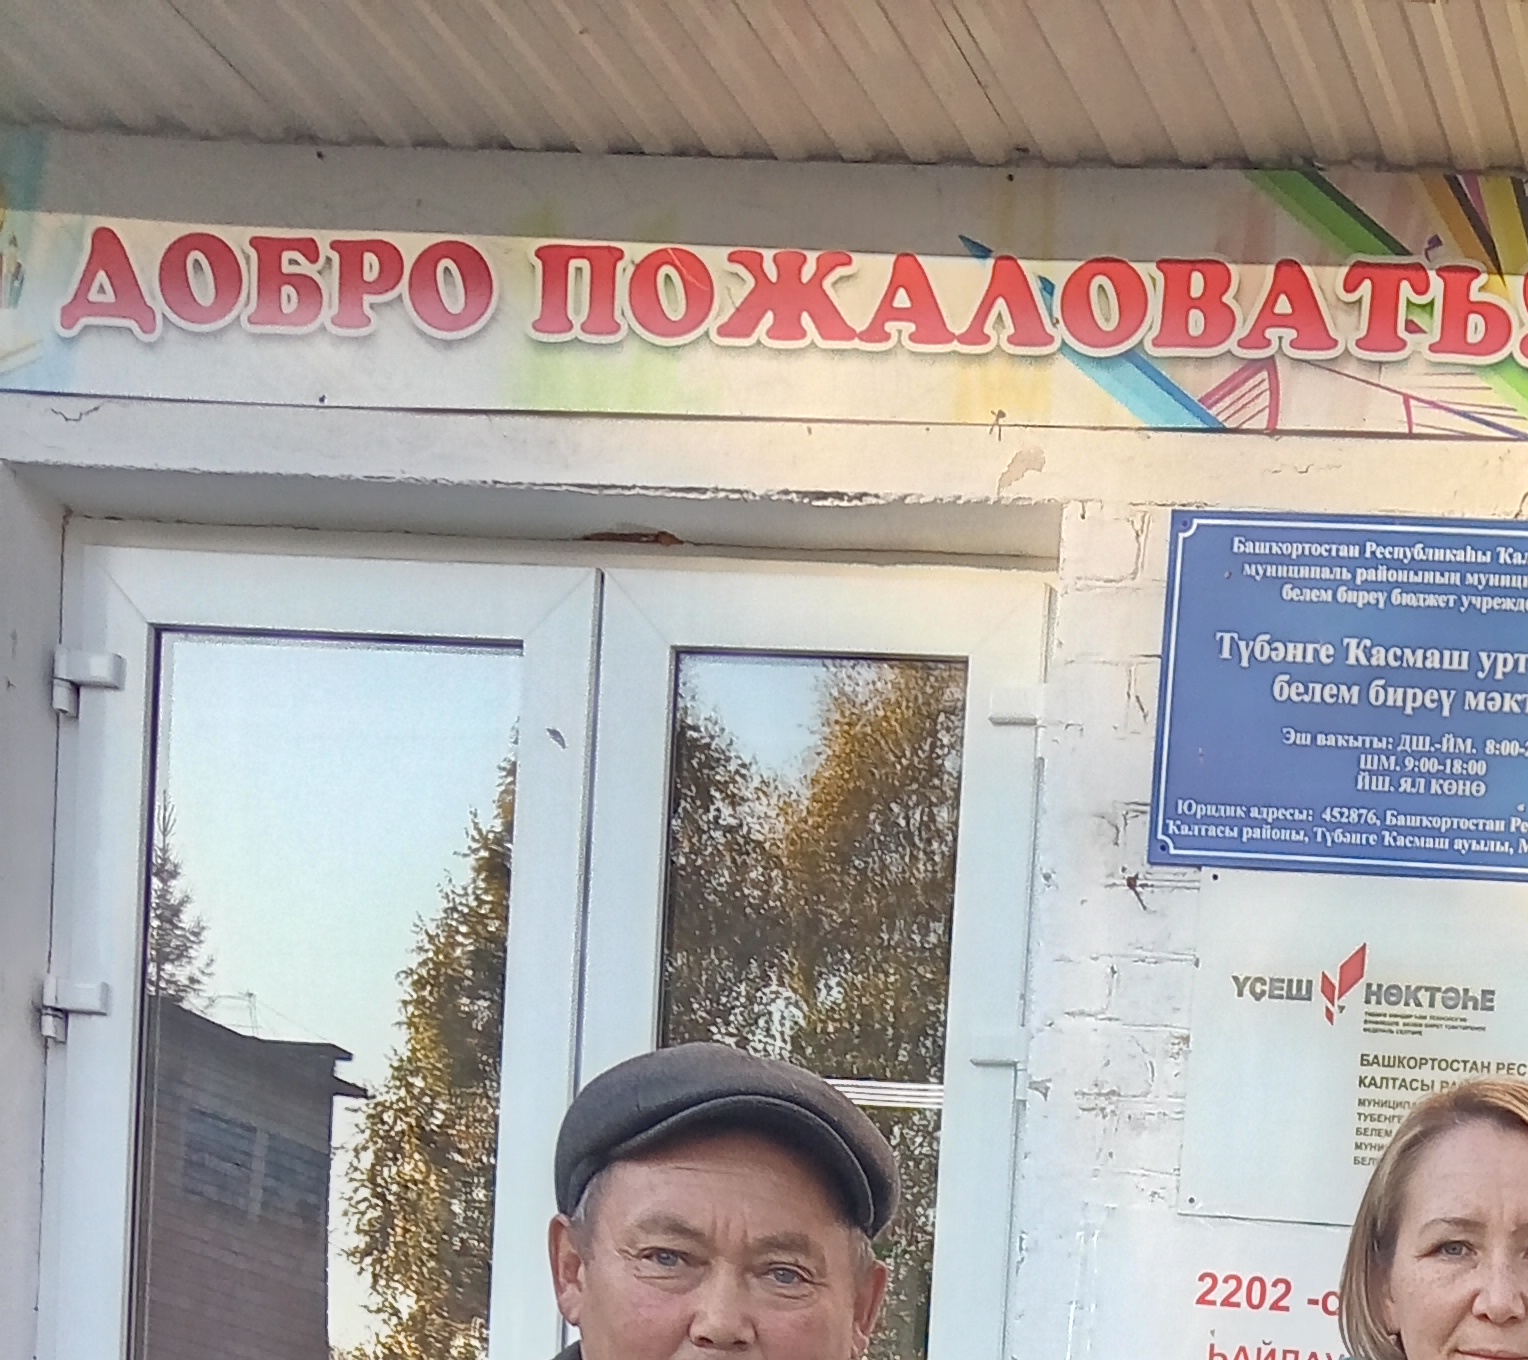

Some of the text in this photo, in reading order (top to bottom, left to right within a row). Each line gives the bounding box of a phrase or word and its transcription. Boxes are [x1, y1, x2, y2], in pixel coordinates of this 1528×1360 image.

[57, 225, 496, 338] ДОБРО
[1364, 541, 1492, 565] Республикаһы
[1242, 562, 1352, 582] муниципаль
[1281, 583, 1332, 603] белем
[1390, 588, 1458, 609] бюджет
[1215, 631, 1336, 669] Түбәнге
[1342, 637, 1470, 672] Ҡасмаш
[1272, 673, 1361, 705] белем
[1368, 679, 1457, 717] биреү
[1282, 727, 1311, 746] Эш
[1397, 732, 1478, 755] ДШ.-ЙМ.
[1359, 753, 1487, 777] ШМ. 9:00-18:00
[1356, 771, 1487, 798] ЙШ. ЯЛ КӨНӨ
[1176, 798, 1247, 818] Юридик
[1249, 805, 1314, 824] адресы:
[1320, 807, 1382, 827] 452876,
[1241, 824, 1309, 845] районы,
[1453, 838, 1514, 857] ауылы,
[1359, 1053, 1491, 1075] БАШКОРТОСТАН
[1358, 1075, 1435, 1093] КАЛТАСЫ
[1355, 1126, 1393, 1138] БЕЛЕМ
[1354, 1141, 1387, 1153] МУНИ
[1353, 1155, 1377, 1167] БЕЛ
[1194, 1271, 1293, 1313] 2202
